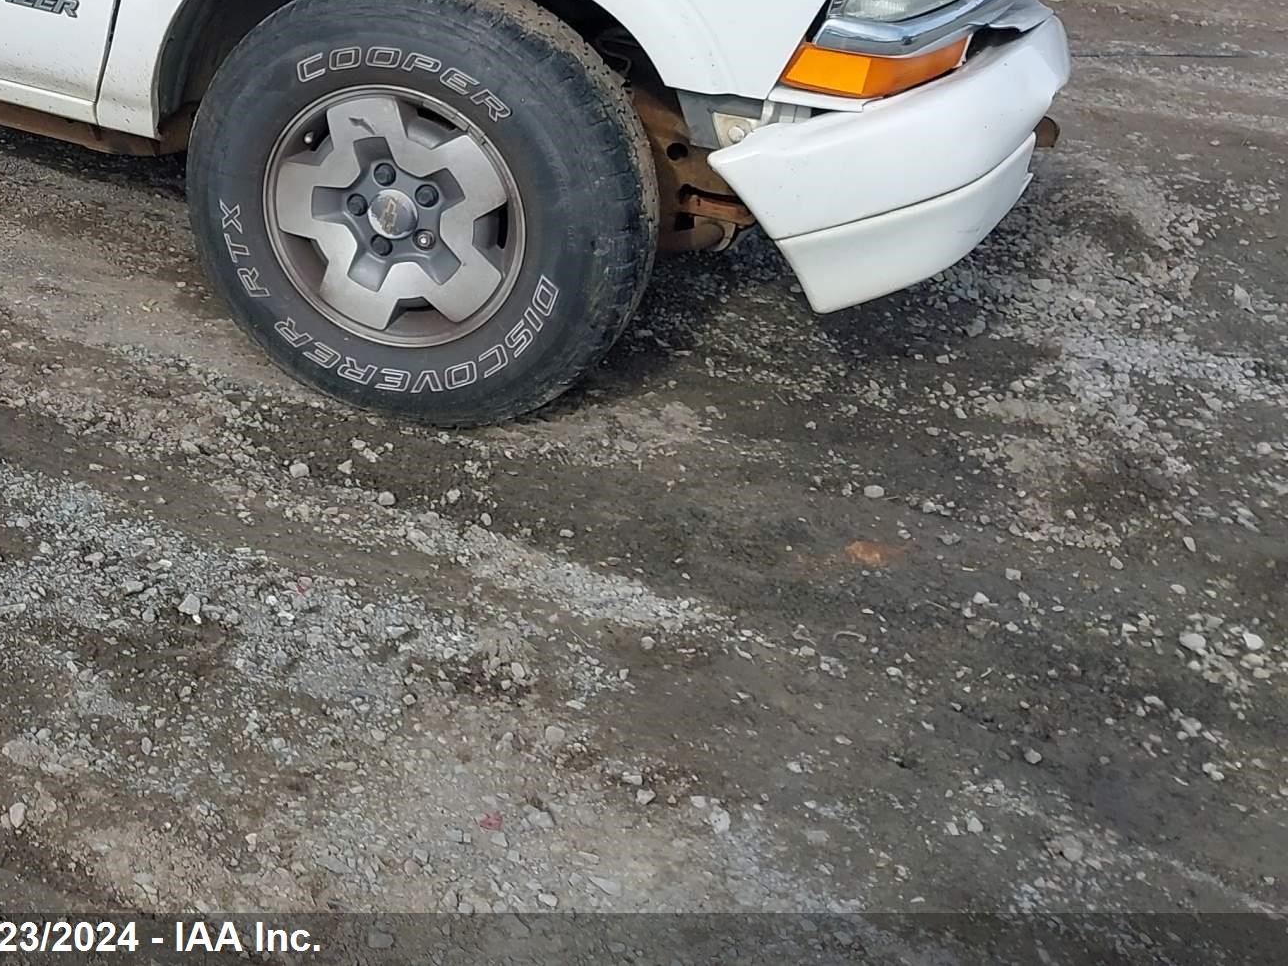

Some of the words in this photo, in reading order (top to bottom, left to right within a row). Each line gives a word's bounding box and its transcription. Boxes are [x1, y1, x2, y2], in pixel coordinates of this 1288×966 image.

[297, 46, 512, 122] COOPER
[218, 199, 271, 299] RTX
[274, 275, 560, 393] DISCOVERER
